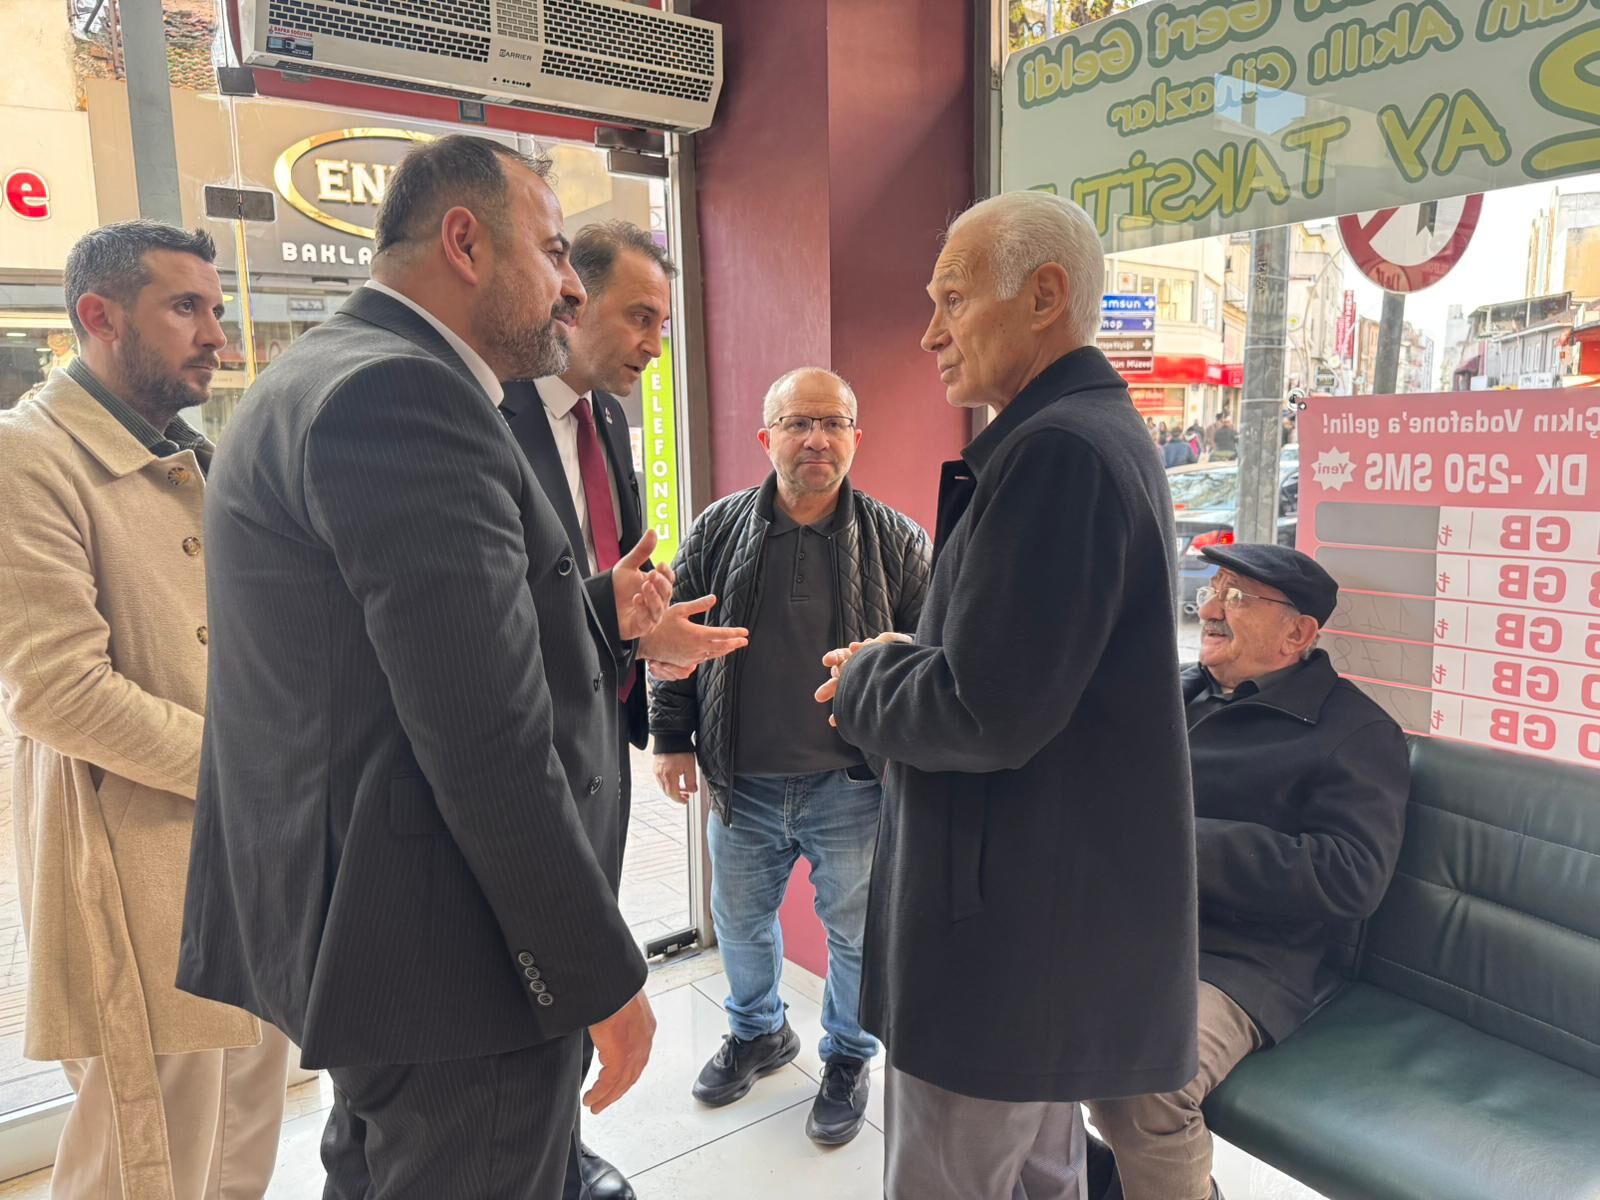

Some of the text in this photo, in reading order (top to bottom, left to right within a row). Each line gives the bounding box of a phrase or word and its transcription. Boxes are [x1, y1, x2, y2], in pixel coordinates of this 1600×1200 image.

[315, 158, 397, 206] EN
[0, 168, 51, 220] e
[282, 242, 373, 265] BAKLA
[1102, 299, 1142, 309] amsun
[1102, 319, 1123, 330] nop
